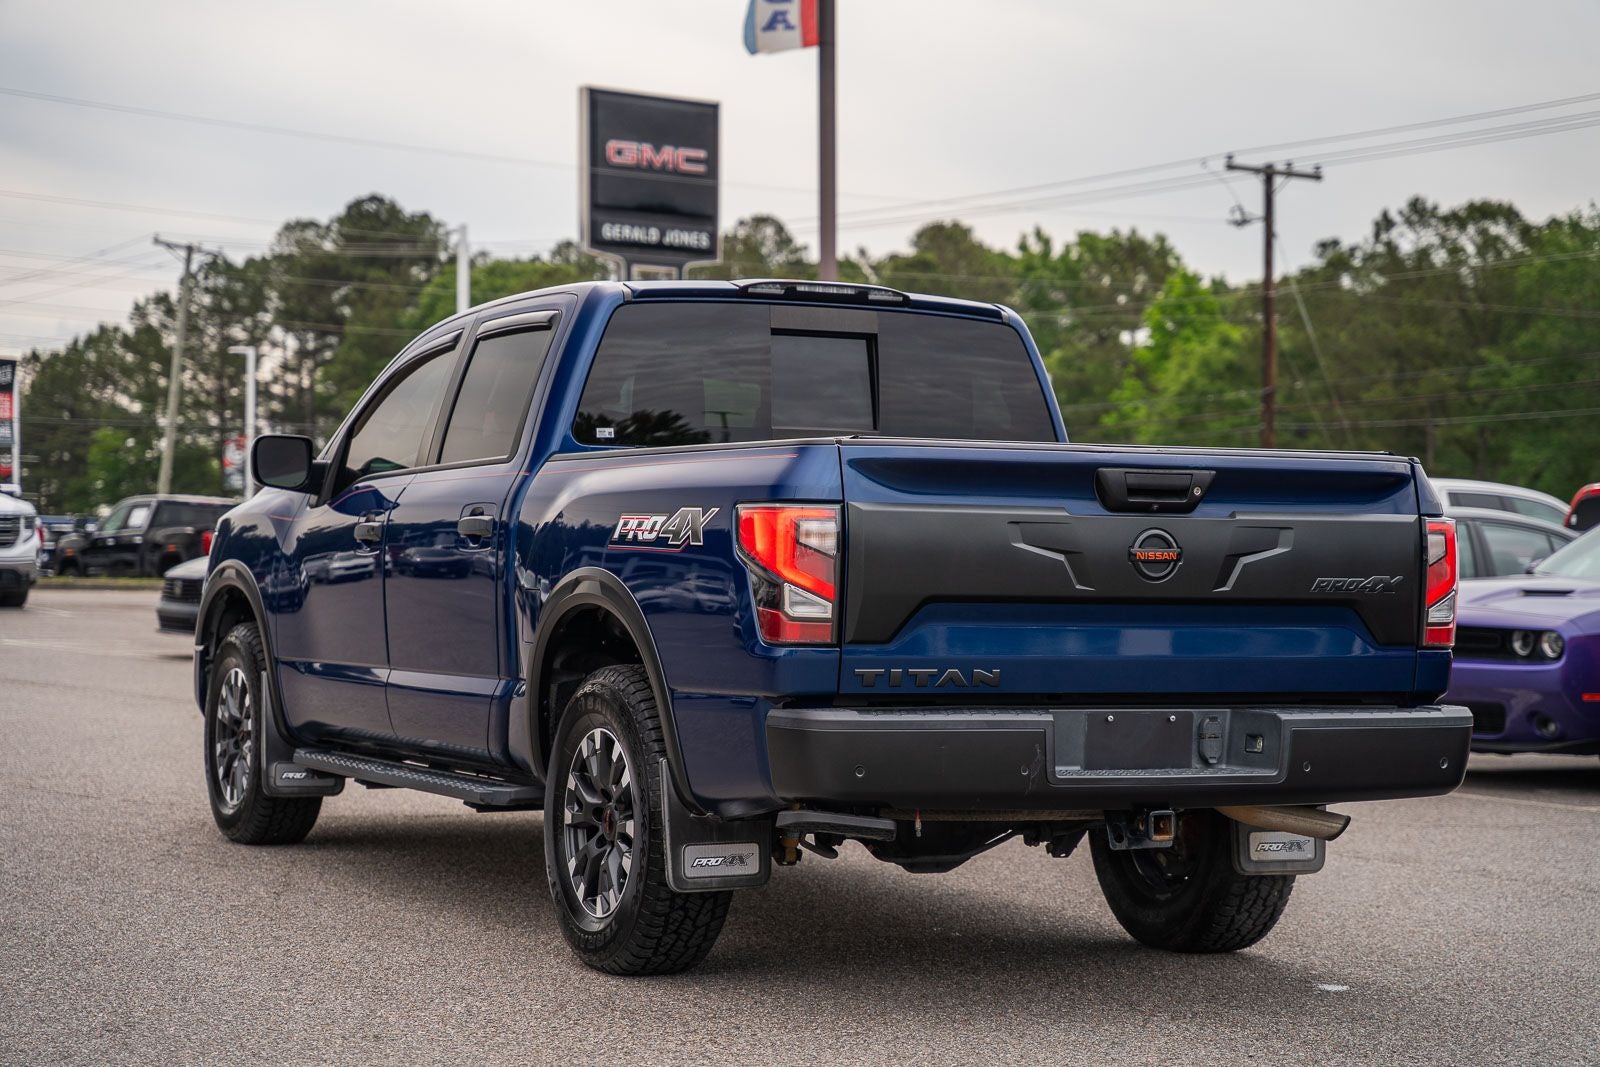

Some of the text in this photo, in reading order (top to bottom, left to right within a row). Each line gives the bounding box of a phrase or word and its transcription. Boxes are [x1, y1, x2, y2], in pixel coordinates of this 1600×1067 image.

[605, 139, 708, 174] GMC
[601, 222, 710, 250] GERALD JONES
[611, 507, 720, 546] PRO4X
[1136, 551, 1177, 560] NISSAN
[854, 668, 1001, 688] TITAN
